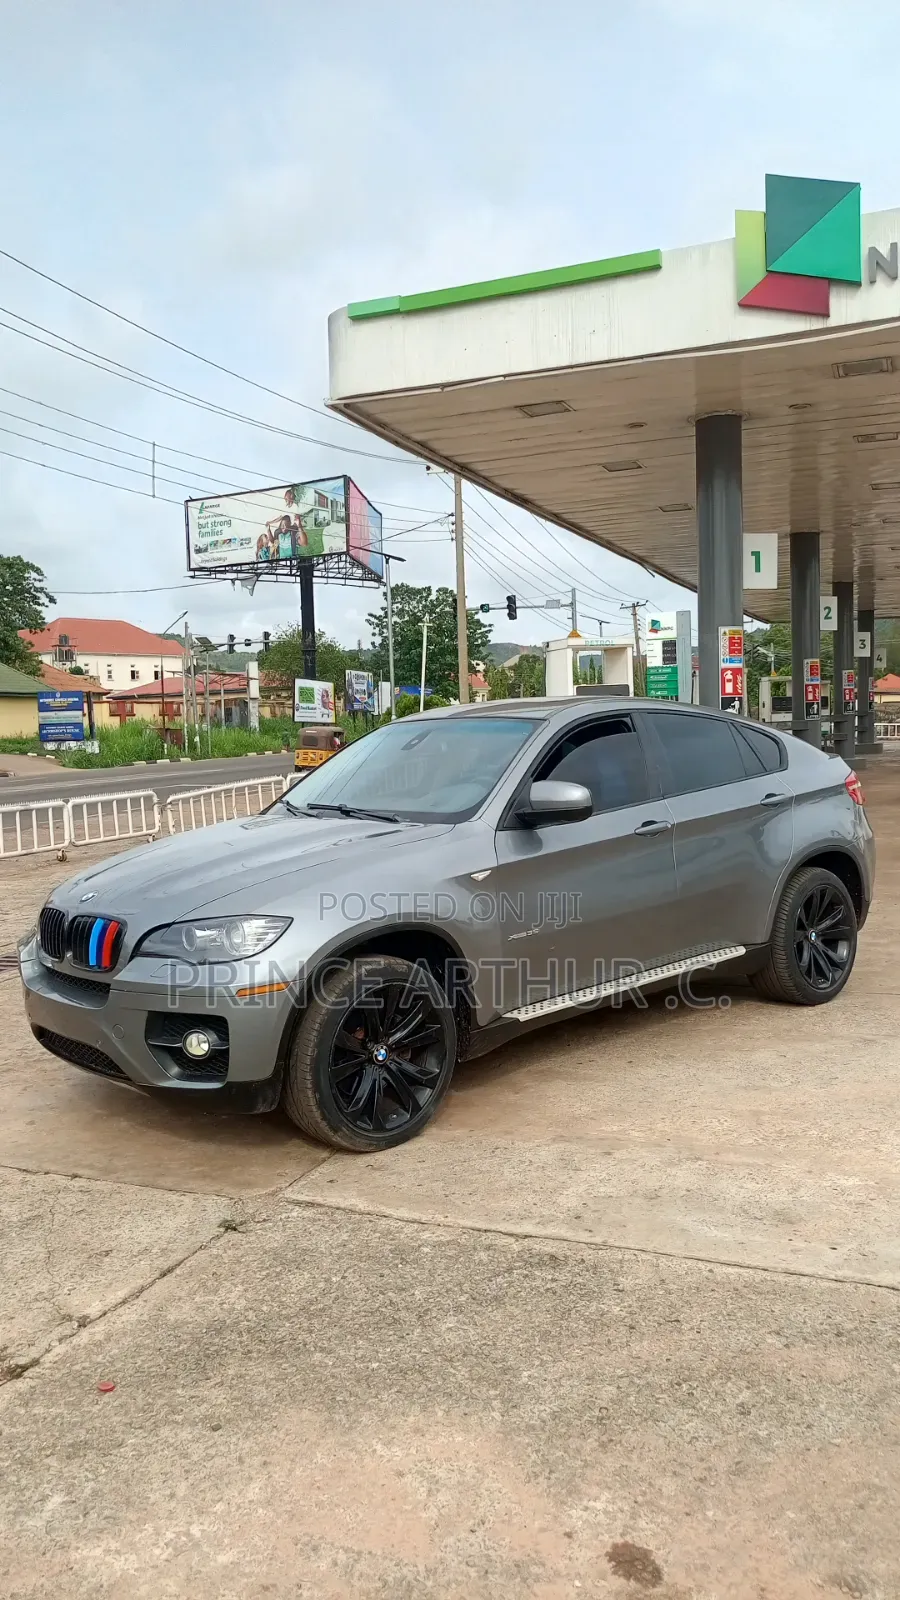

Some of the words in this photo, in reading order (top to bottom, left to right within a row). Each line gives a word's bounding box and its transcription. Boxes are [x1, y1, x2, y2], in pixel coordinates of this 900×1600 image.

[868, 242, 899, 284] N
[198, 521, 209, 530] but
[210, 519, 232, 528] strong
[198, 529, 223, 538] families
[750, 551, 761, 572] 1
[823, 606, 833, 620] 2
[584, 639, 616, 647] PETROL
[858, 639, 867, 651] 3
[875, 654, 883, 662] 4
